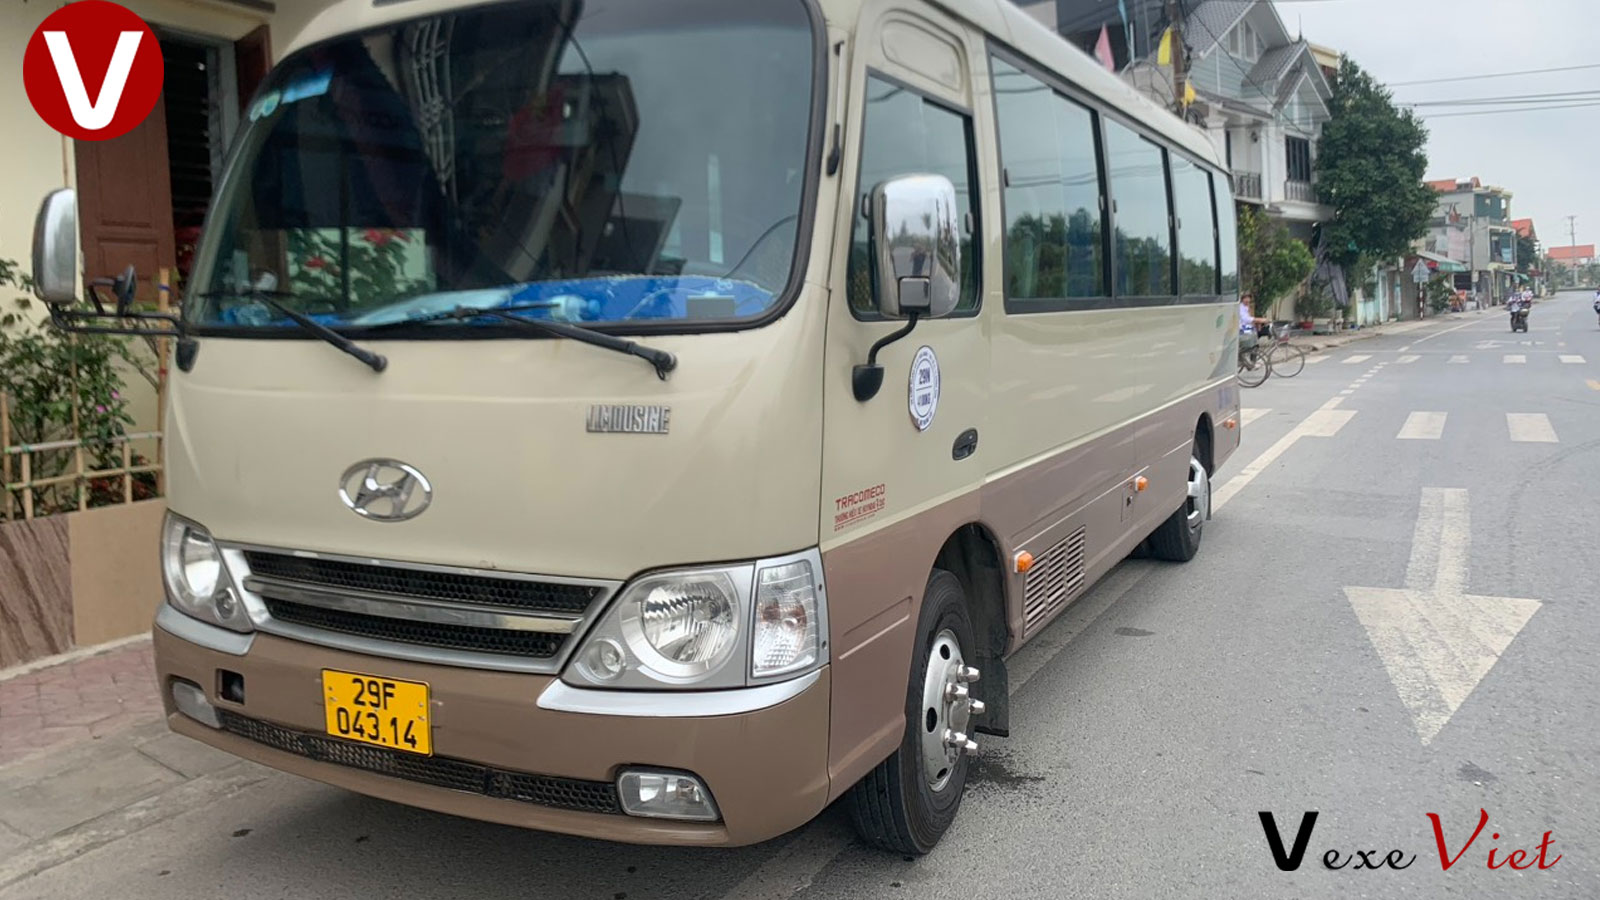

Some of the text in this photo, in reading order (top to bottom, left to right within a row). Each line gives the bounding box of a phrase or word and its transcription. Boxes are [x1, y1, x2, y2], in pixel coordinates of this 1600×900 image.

[586, 404, 671, 434] LIMOUSINE
[835, 483, 886, 511] TRACOMECO
[352, 678, 395, 710] 29F
[336, 706, 417, 749] 043.14
